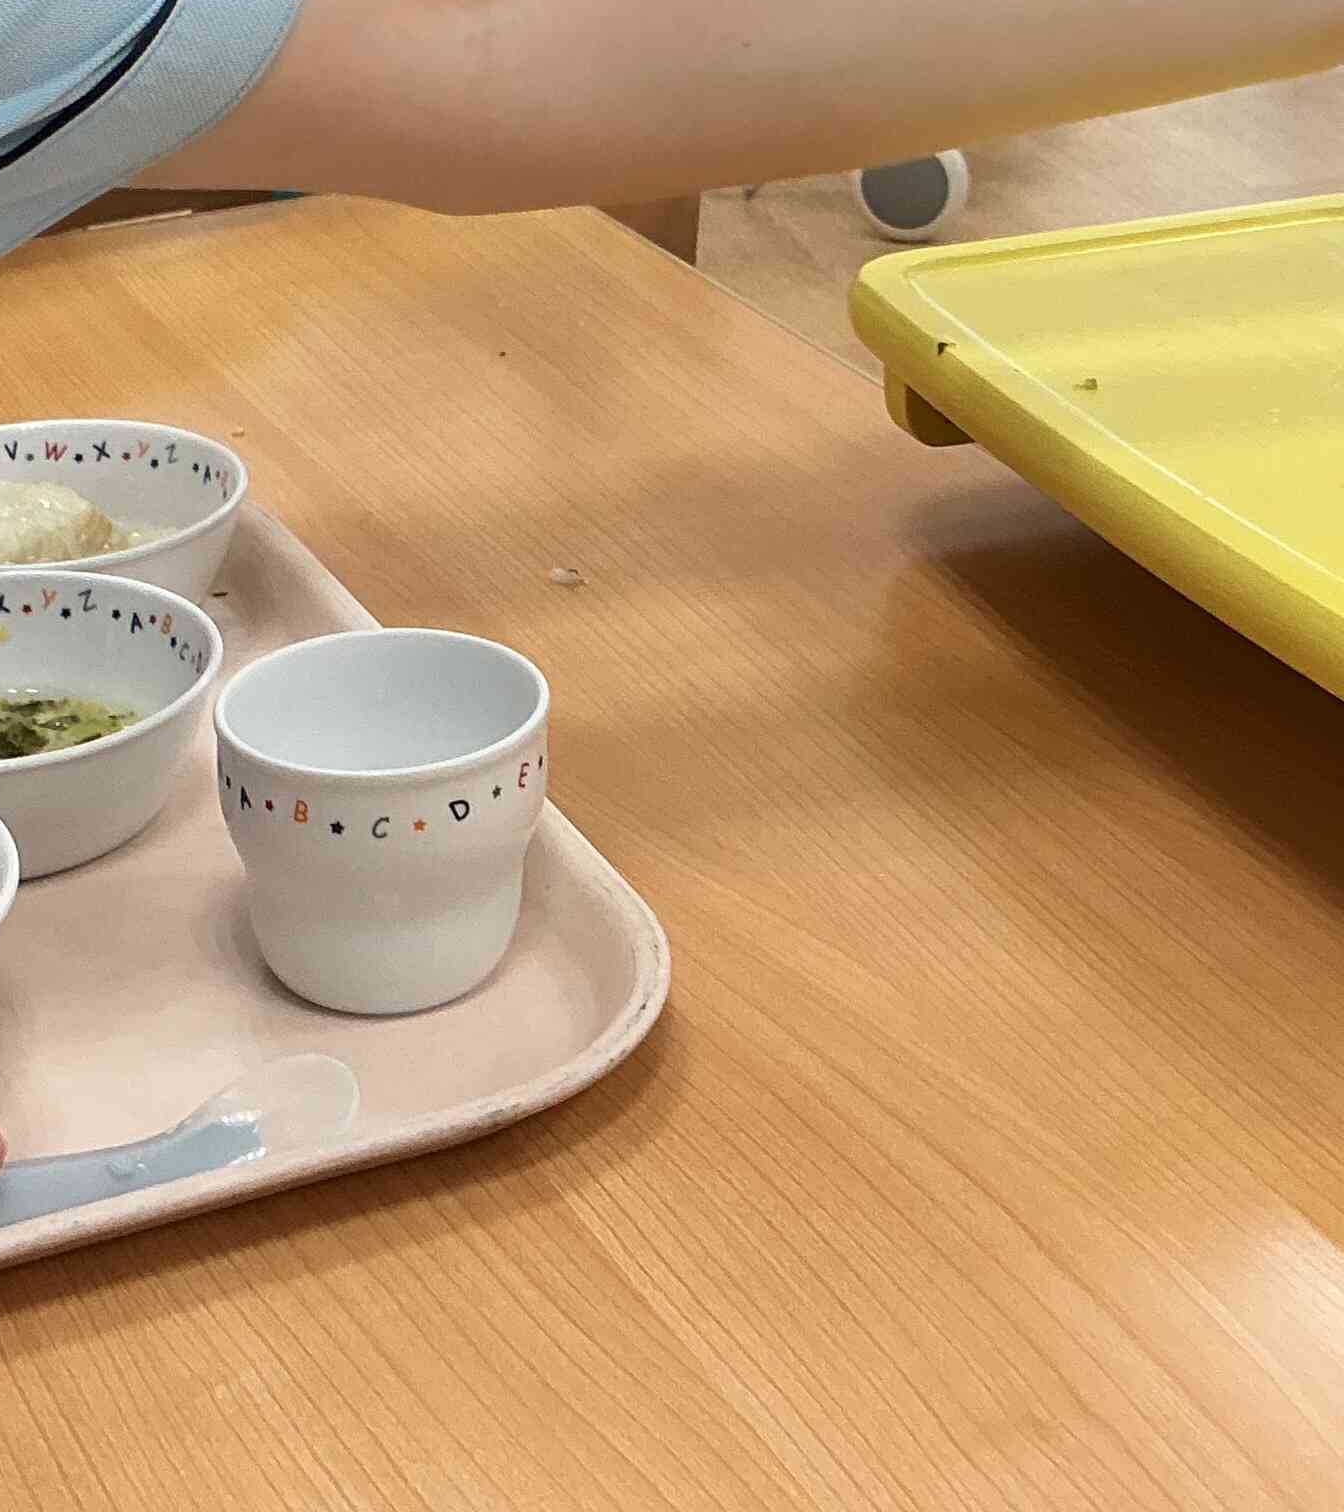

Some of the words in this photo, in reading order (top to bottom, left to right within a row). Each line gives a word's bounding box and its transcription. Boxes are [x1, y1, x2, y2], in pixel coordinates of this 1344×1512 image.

[4, 441, 18, 461] V
[45, 440, 68, 462] W
[93, 441, 111, 462] X
[137, 439, 150, 459] Y
[164, 443, 178, 464] Z
[40, 587, 56, 610] Y
[77, 588, 97, 612] Z
[130, 612, 144, 634] A
[161, 612, 173, 634] B
[239, 786, 252, 811] A
[293, 799, 309, 824] B
[371, 816, 391, 839] C
[448, 799, 471, 822] D
[517, 762, 530, 788] E
